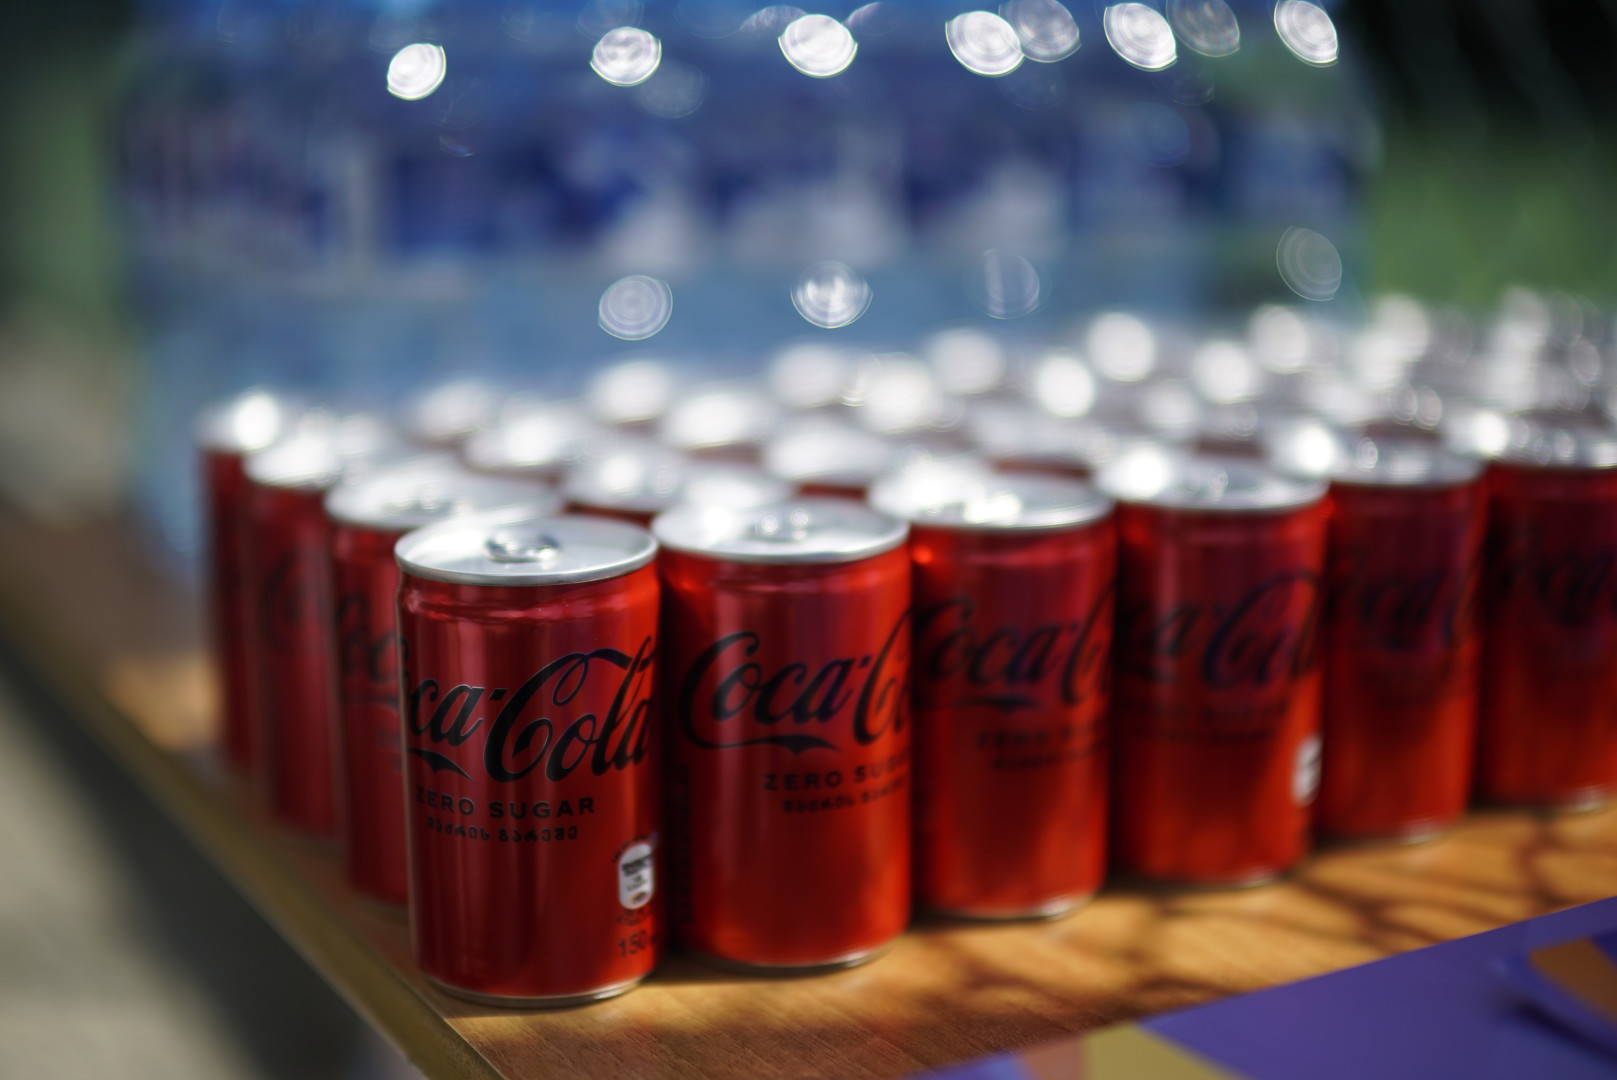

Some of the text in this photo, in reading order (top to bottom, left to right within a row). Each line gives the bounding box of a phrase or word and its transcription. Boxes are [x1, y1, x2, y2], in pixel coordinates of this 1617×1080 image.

[401, 636, 654, 783] ca-Cola
[678, 608, 913, 756] Coca-C
[415, 784, 596, 820] ZERO SUGAR
[762, 771, 842, 792] ZERO
